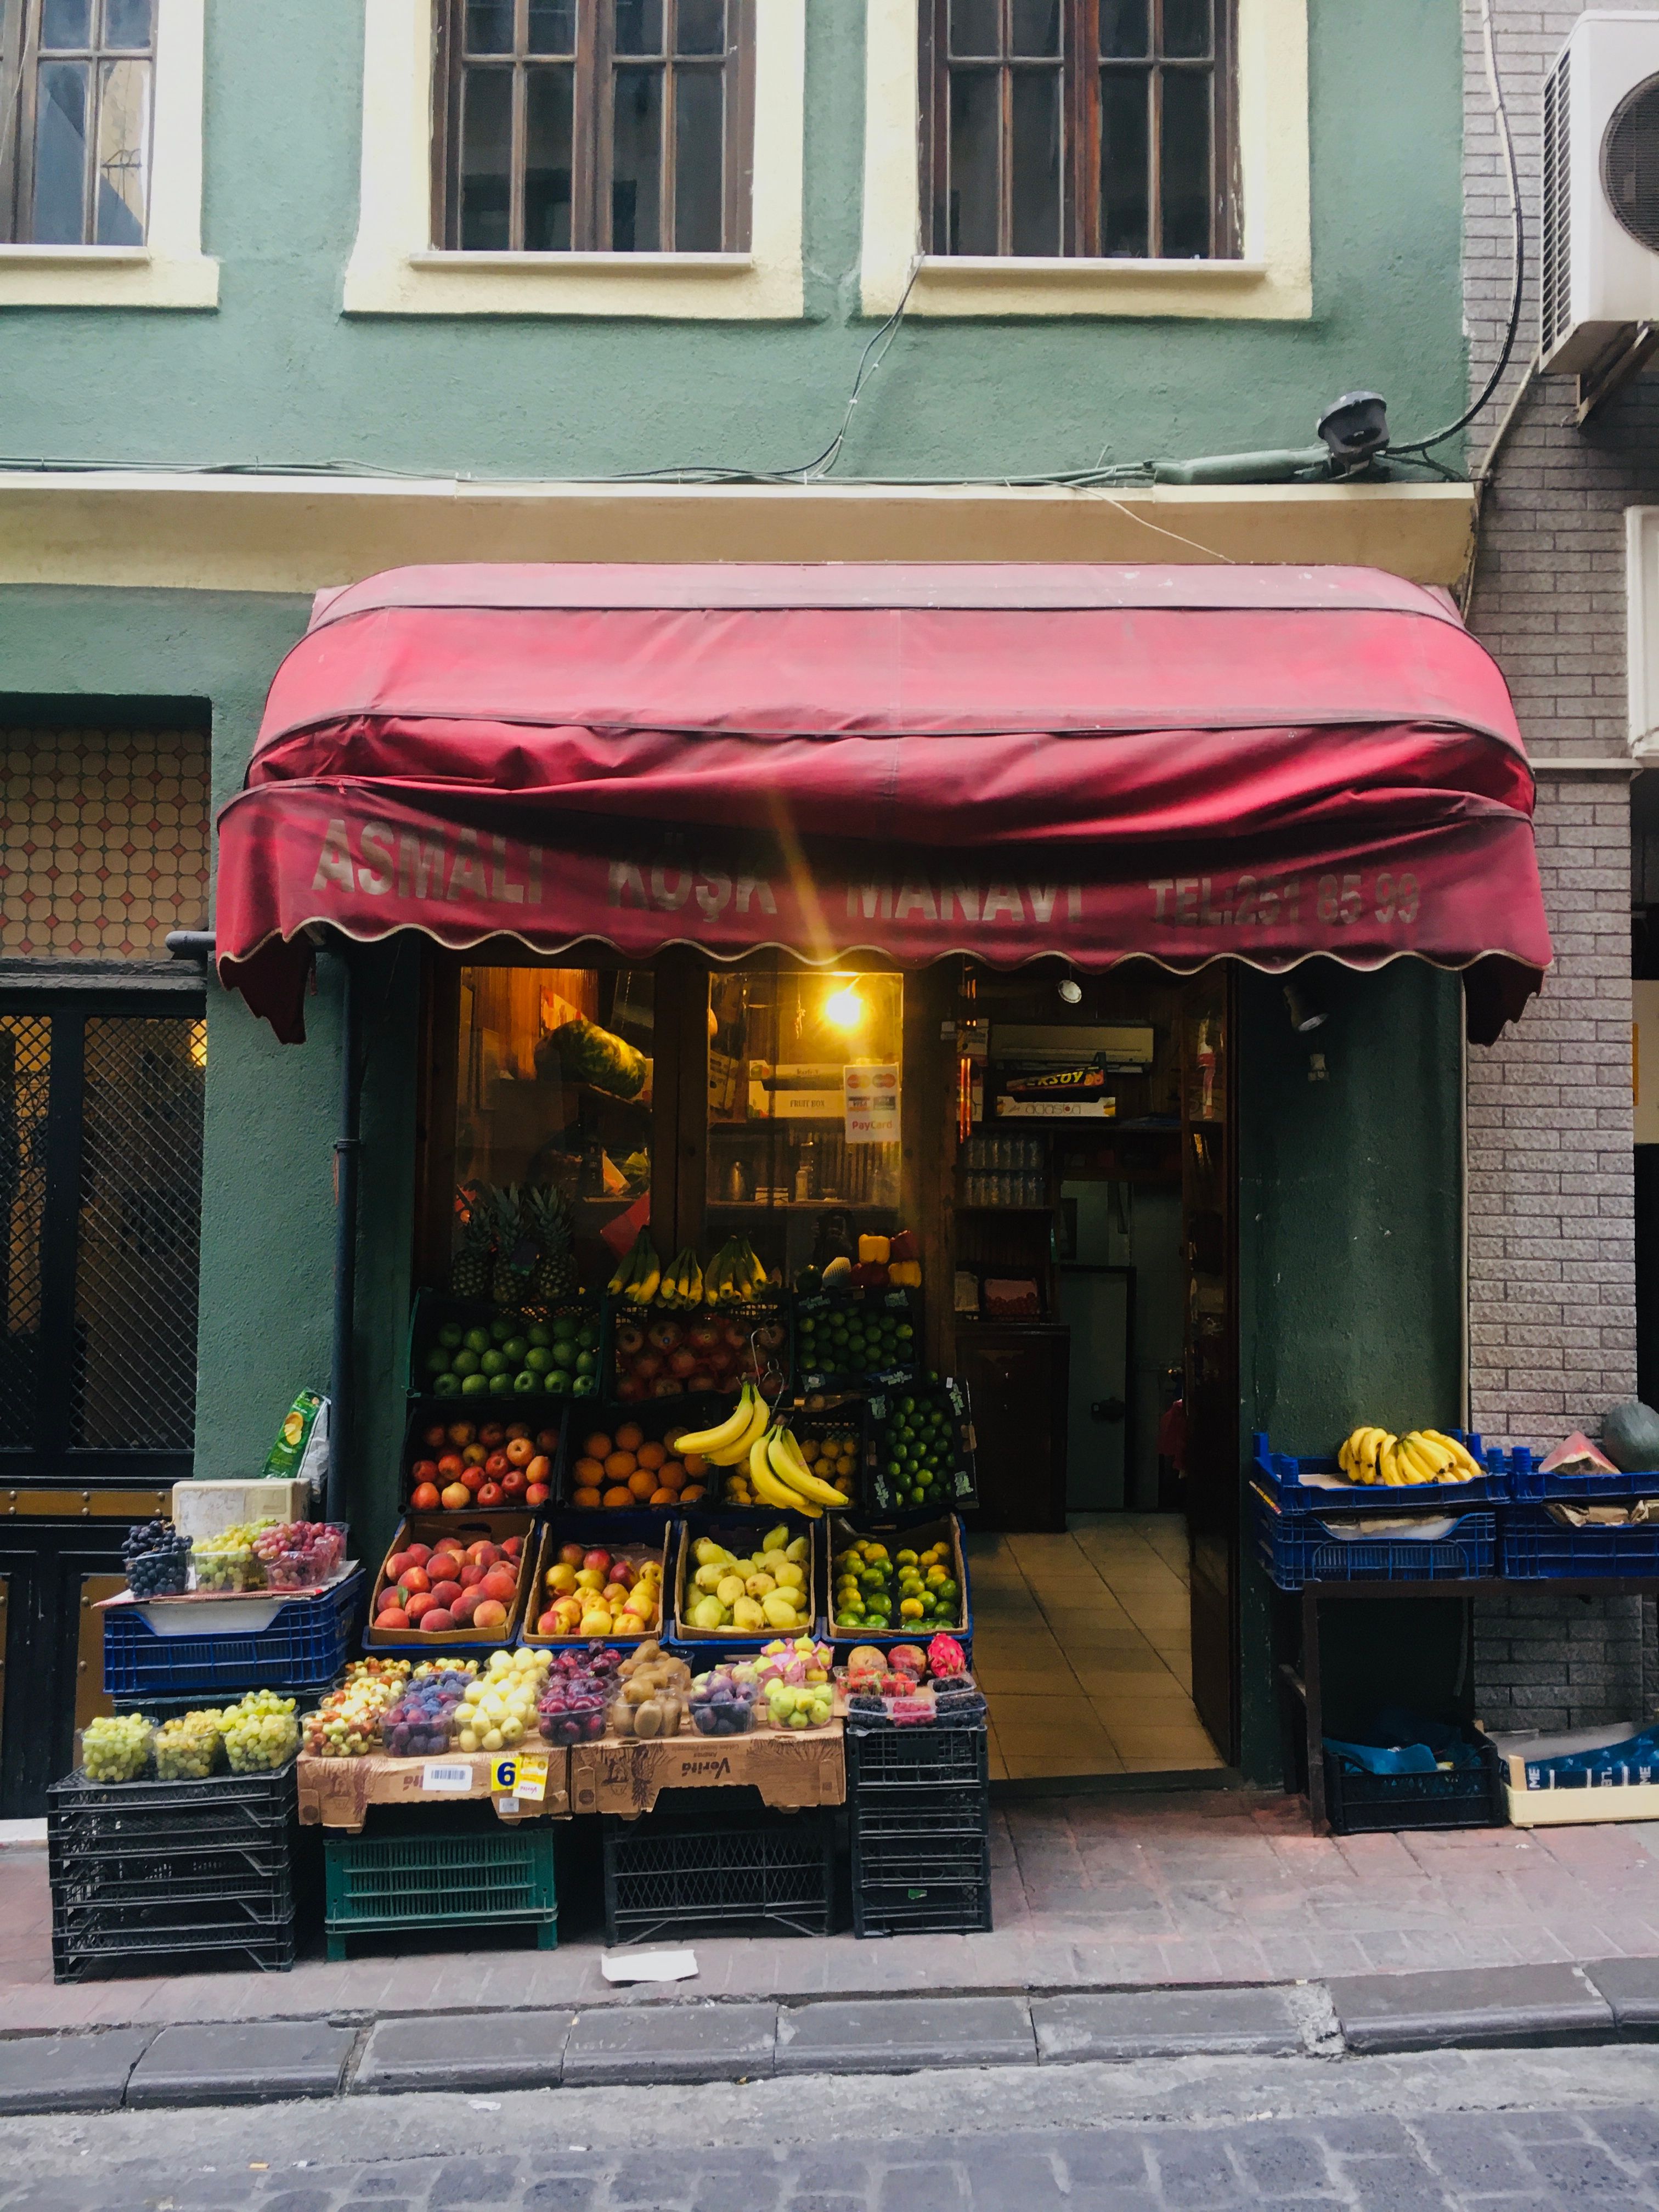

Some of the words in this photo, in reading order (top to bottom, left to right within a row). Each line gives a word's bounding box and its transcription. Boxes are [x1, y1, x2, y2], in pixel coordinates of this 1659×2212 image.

[312, 820, 543, 904] ASMALI
[845, 865, 1082, 923] MANAVI
[1317, 874, 1362, 925] 85
[1375, 872, 1420, 924] 99
[852, 1120, 893, 1131] PayCard
[497, 1762, 516, 1786] 6
